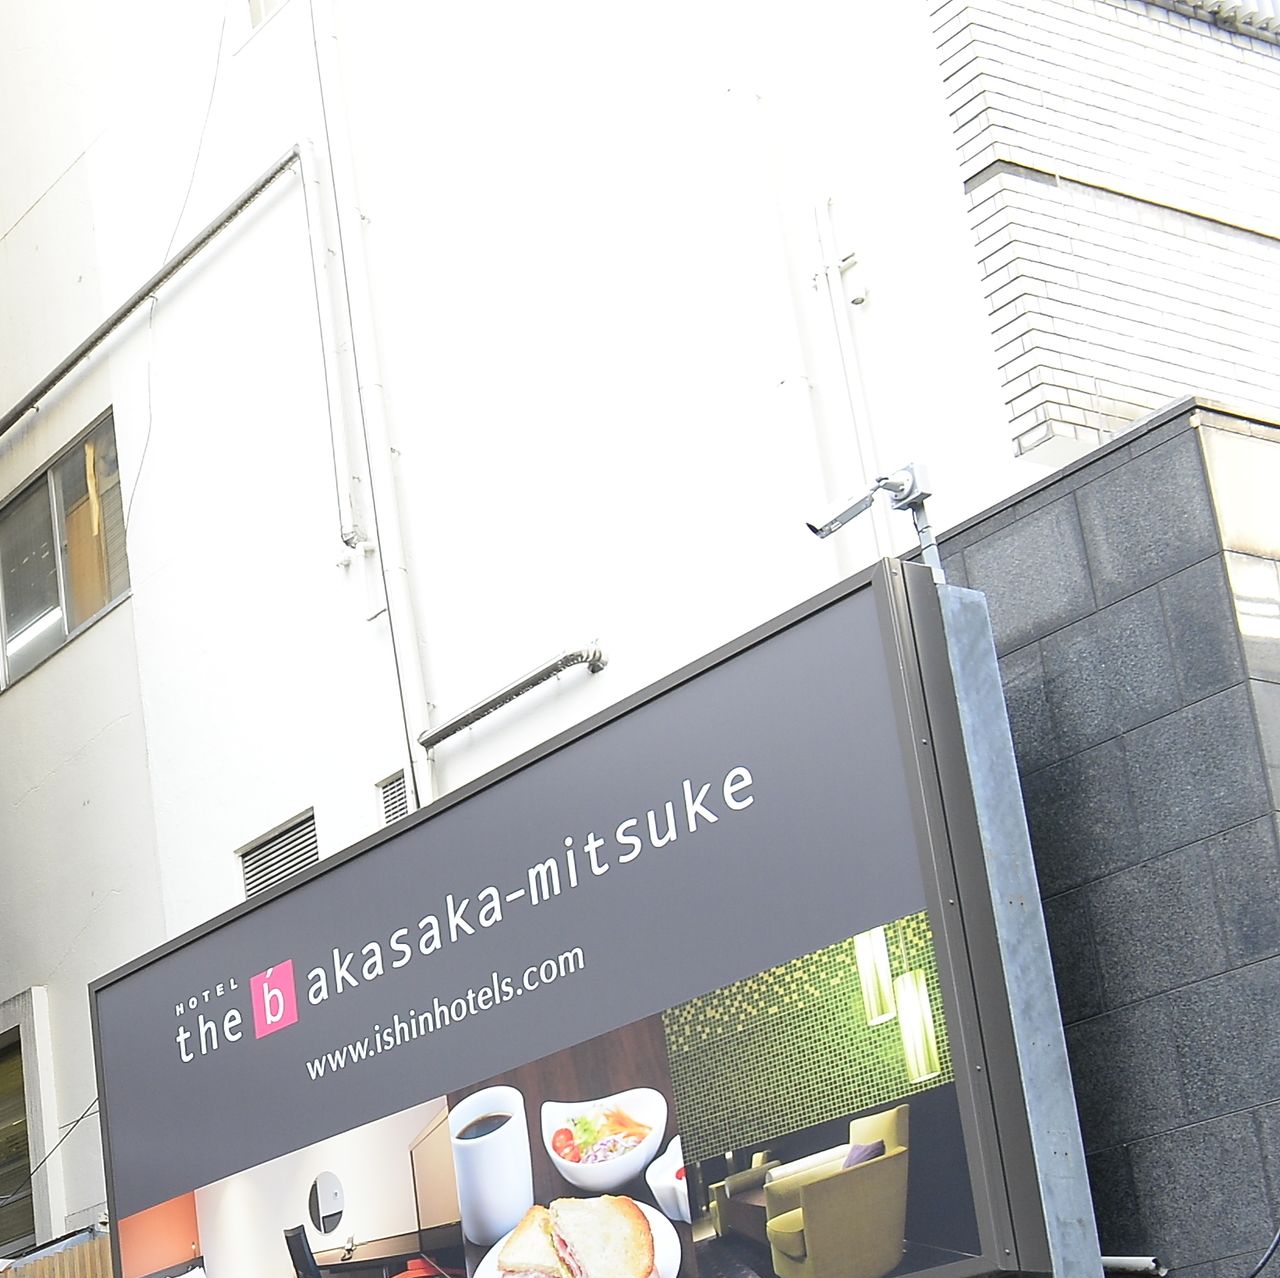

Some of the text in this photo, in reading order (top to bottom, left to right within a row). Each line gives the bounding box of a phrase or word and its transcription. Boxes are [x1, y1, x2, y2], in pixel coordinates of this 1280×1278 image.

[175, 1006, 244, 1063] the
[307, 764, 755, 1005] akasaka-mitsuke
[174, 977, 240, 1017] HOTEL
[306, 946, 586, 1081] www.ishinhotels.com
